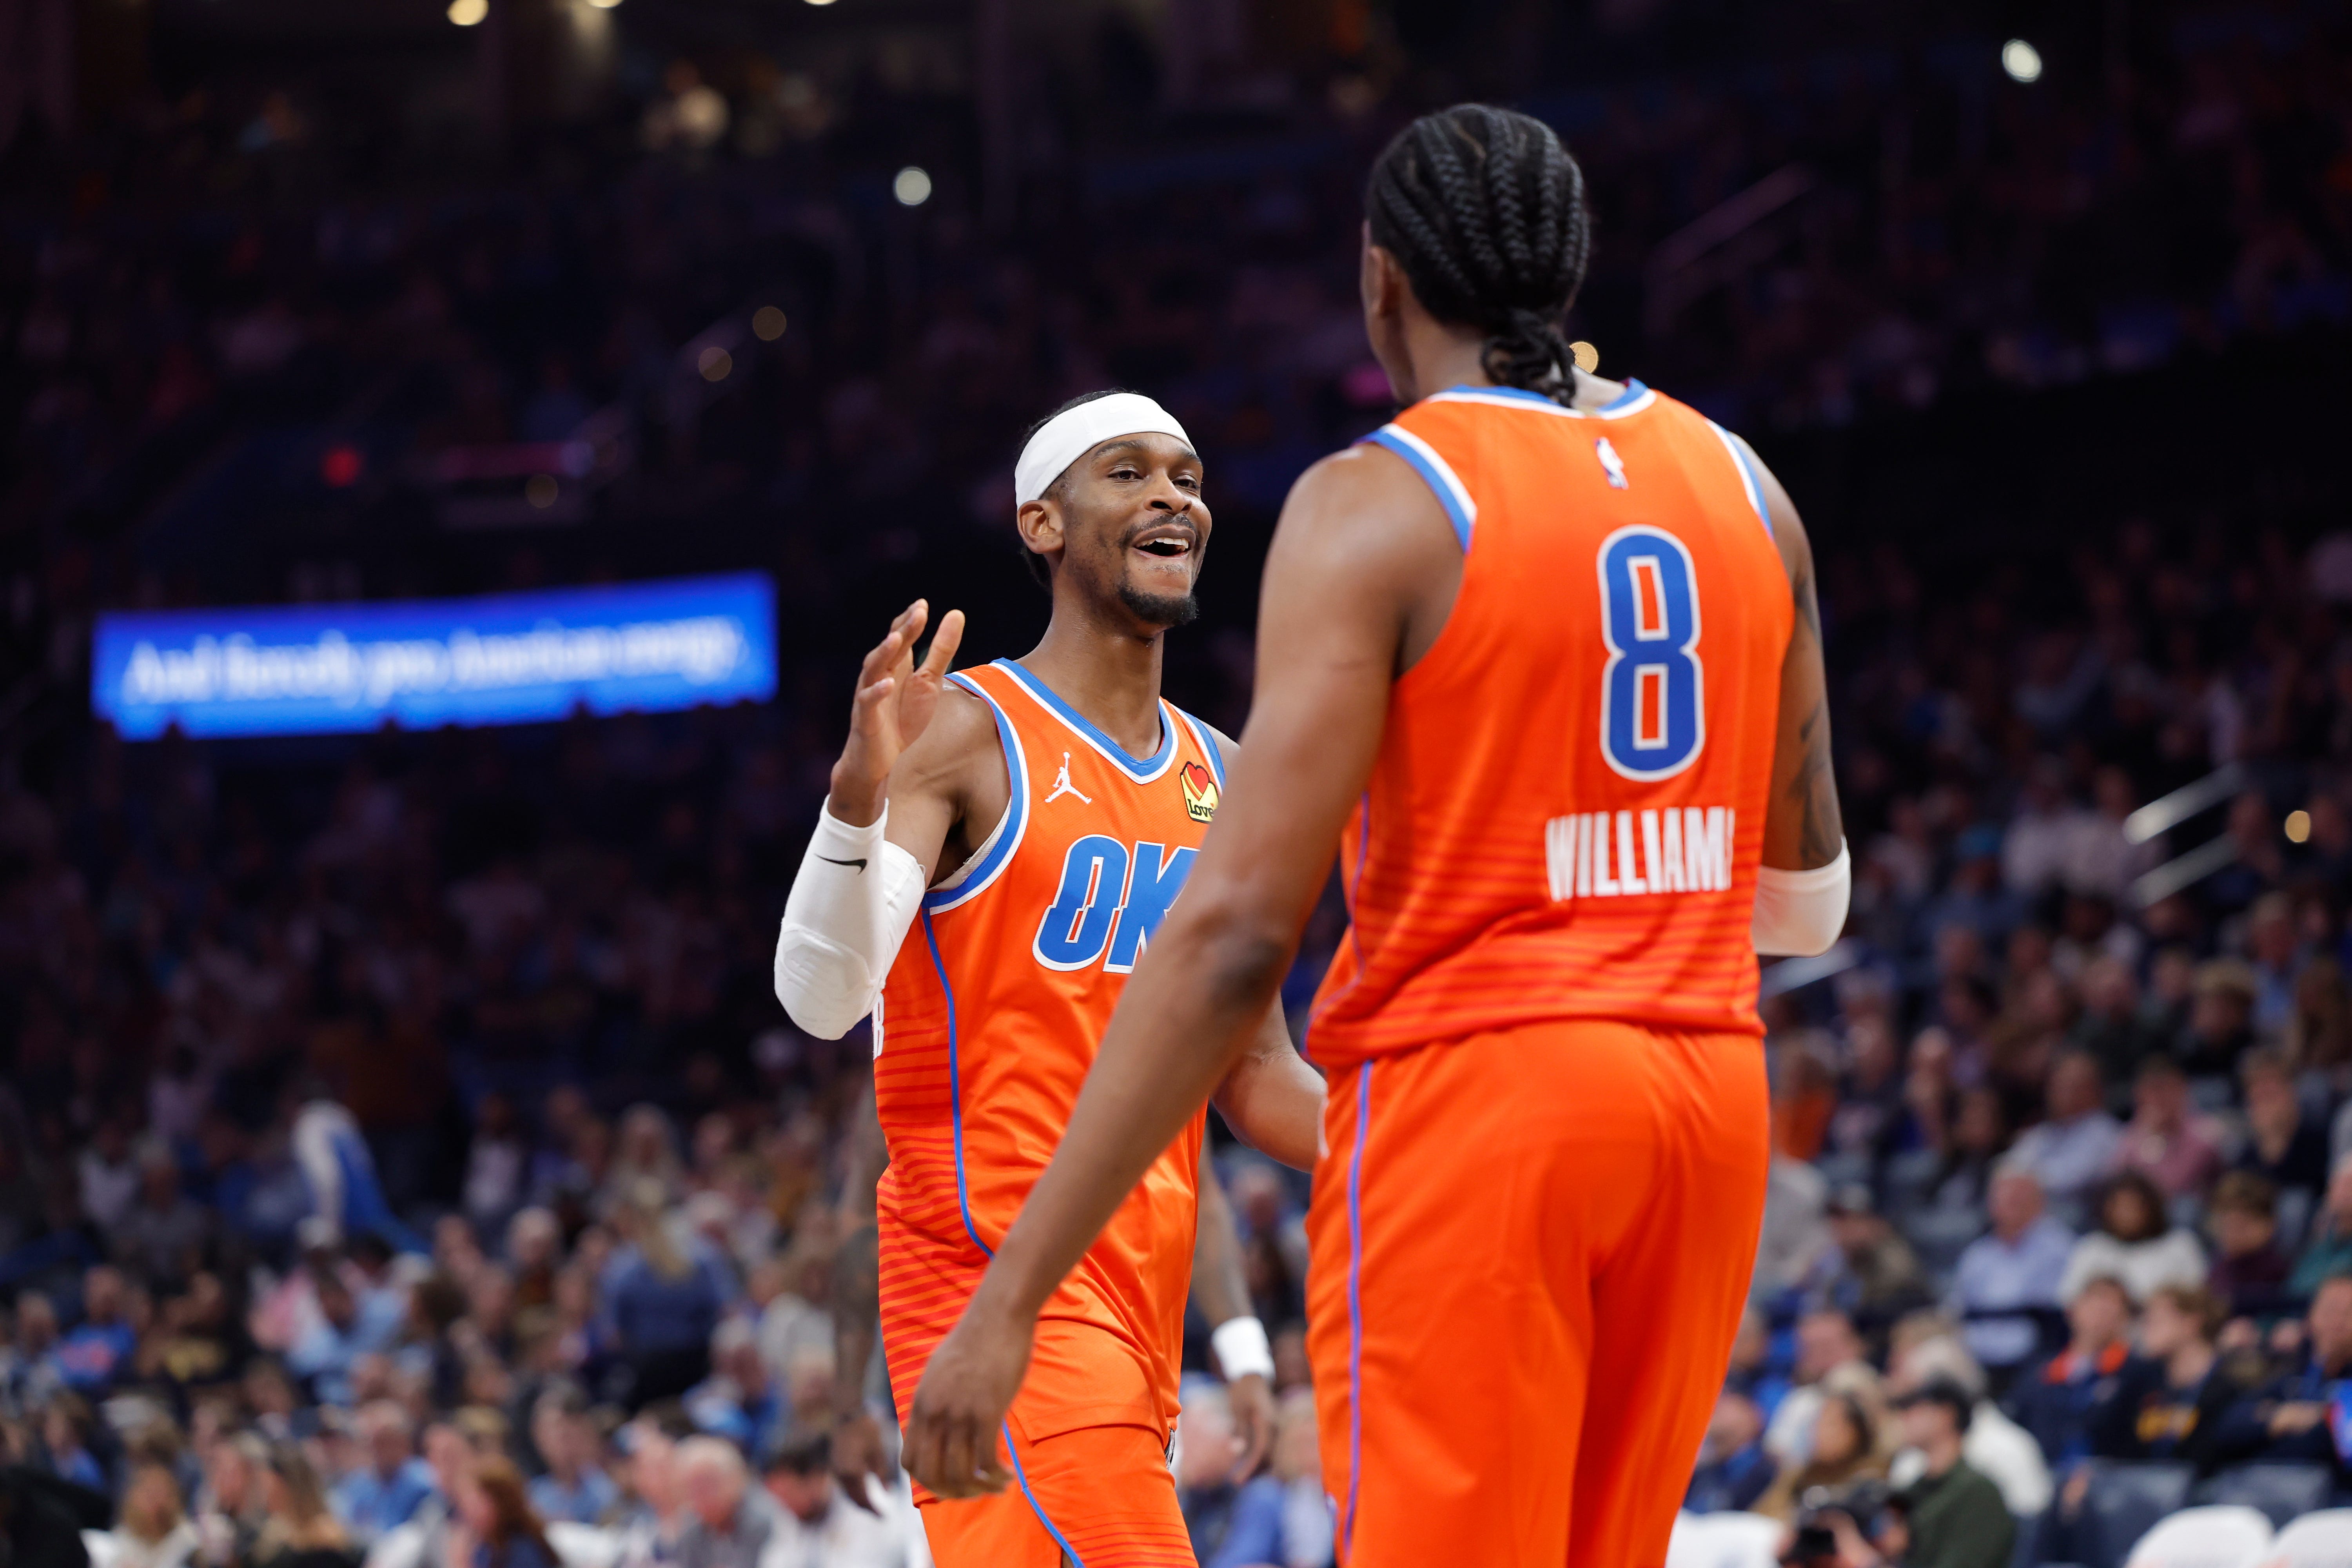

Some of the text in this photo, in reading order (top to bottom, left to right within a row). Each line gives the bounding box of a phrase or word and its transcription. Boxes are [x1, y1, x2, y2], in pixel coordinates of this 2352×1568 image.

[1596, 524, 1705, 782] 8
[1187, 799, 1215, 818] Love
[1032, 834, 1200, 974] OK
